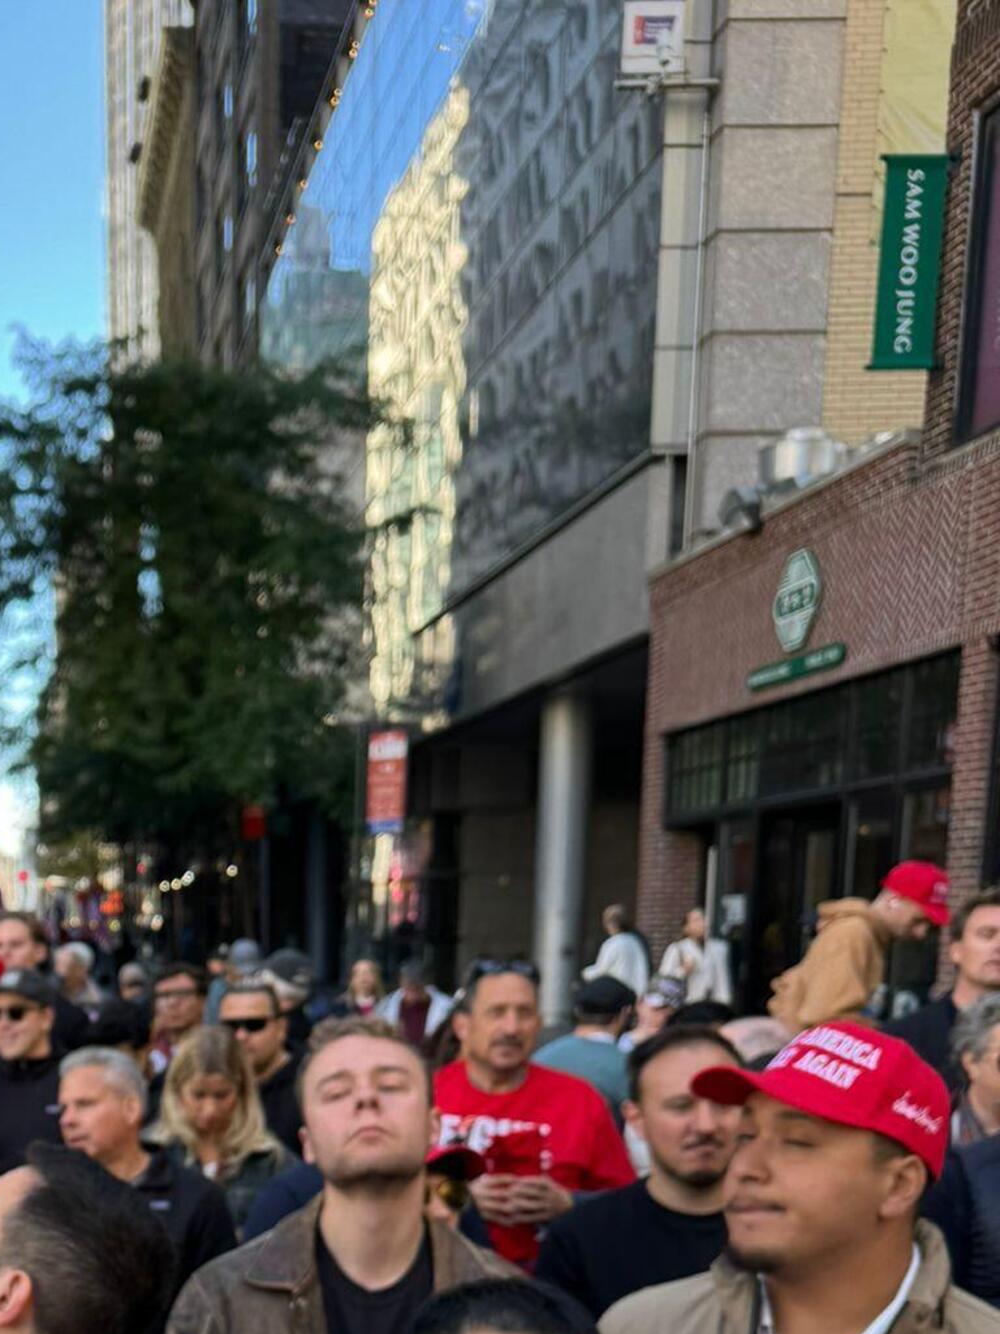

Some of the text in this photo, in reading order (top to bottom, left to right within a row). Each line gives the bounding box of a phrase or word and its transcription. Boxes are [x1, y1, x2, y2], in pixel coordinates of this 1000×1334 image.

[894, 168, 926, 354] SAM WOO JUNG
[792, 1050, 863, 1090] AGAIN
[800, 1026, 883, 1071] AMERICA
